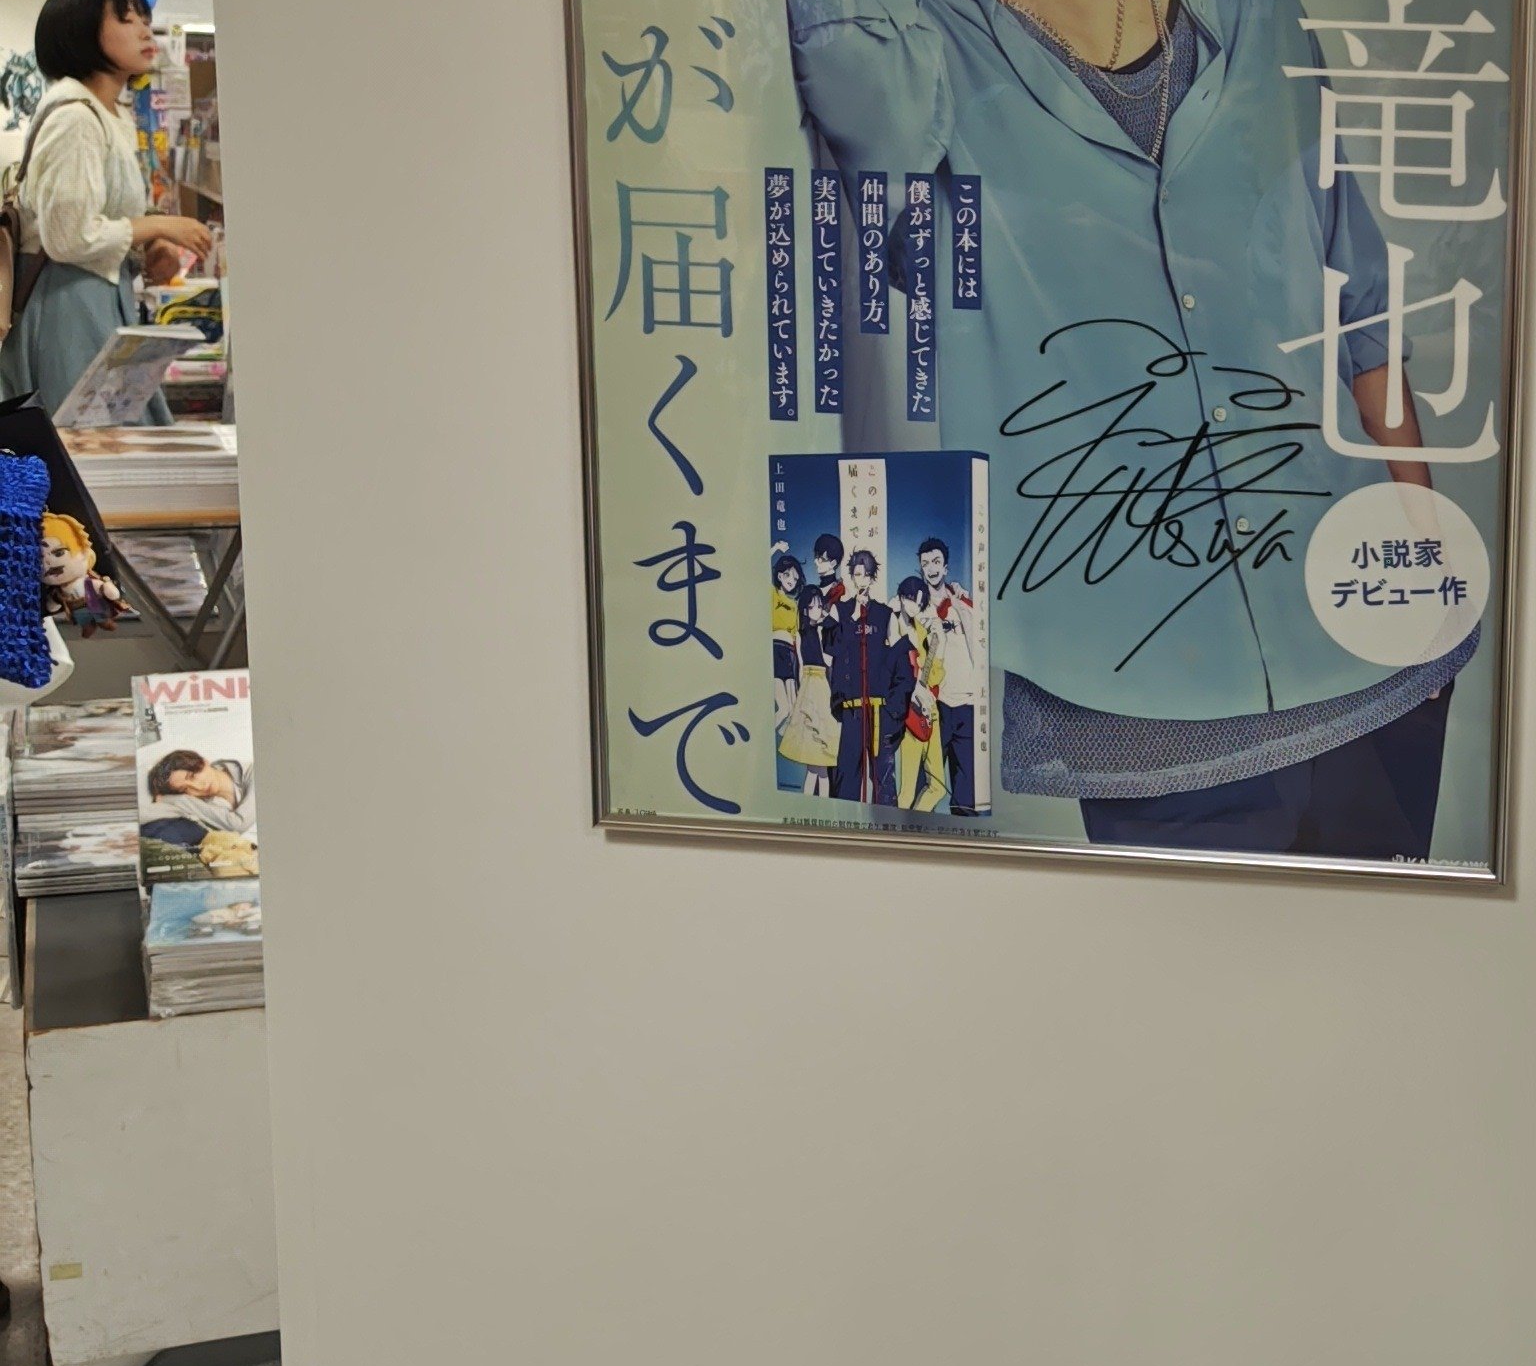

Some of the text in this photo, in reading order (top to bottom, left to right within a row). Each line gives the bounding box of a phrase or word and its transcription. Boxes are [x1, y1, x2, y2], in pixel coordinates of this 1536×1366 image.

[861, 178, 887, 330] 仲間のあり方、
[956, 183, 978, 299] この本には
[767, 175, 796, 417] 夢が込められています。
[814, 176, 839, 406] 実現していきたかった
[908, 180, 932, 414] 僕がずっと感じてきた
[774, 462, 787, 532] 上田竜也
[848, 463, 859, 540] 届くまで
[866, 464, 879, 539] この声が
[1330, 575, 1468, 609] デビュー作
[1351, 537, 1444, 570] 小説家
